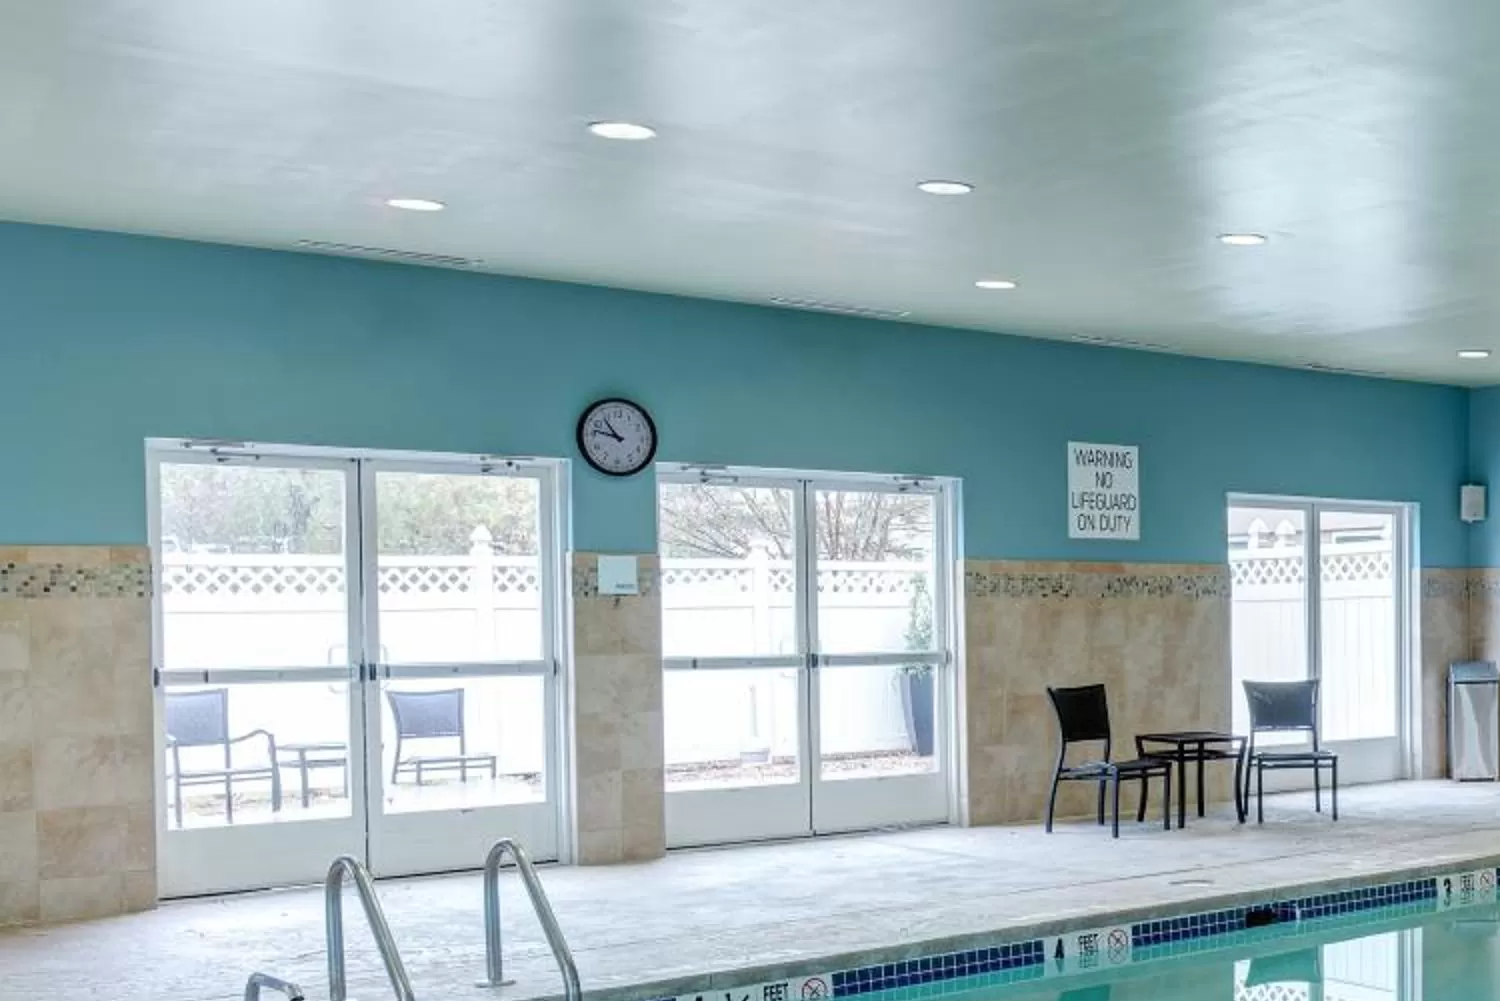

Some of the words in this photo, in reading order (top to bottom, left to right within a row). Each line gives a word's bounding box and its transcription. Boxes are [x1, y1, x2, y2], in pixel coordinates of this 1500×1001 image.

[1073, 447, 1133, 470] WARNING
[1095, 471, 1113, 489] NO
[1071, 491, 1137, 511] LIFEGUARD
[1077, 513, 1095, 531] ON
[1100, 513, 1132, 533] DUTY
[763, 983, 788, 1001] FEET
